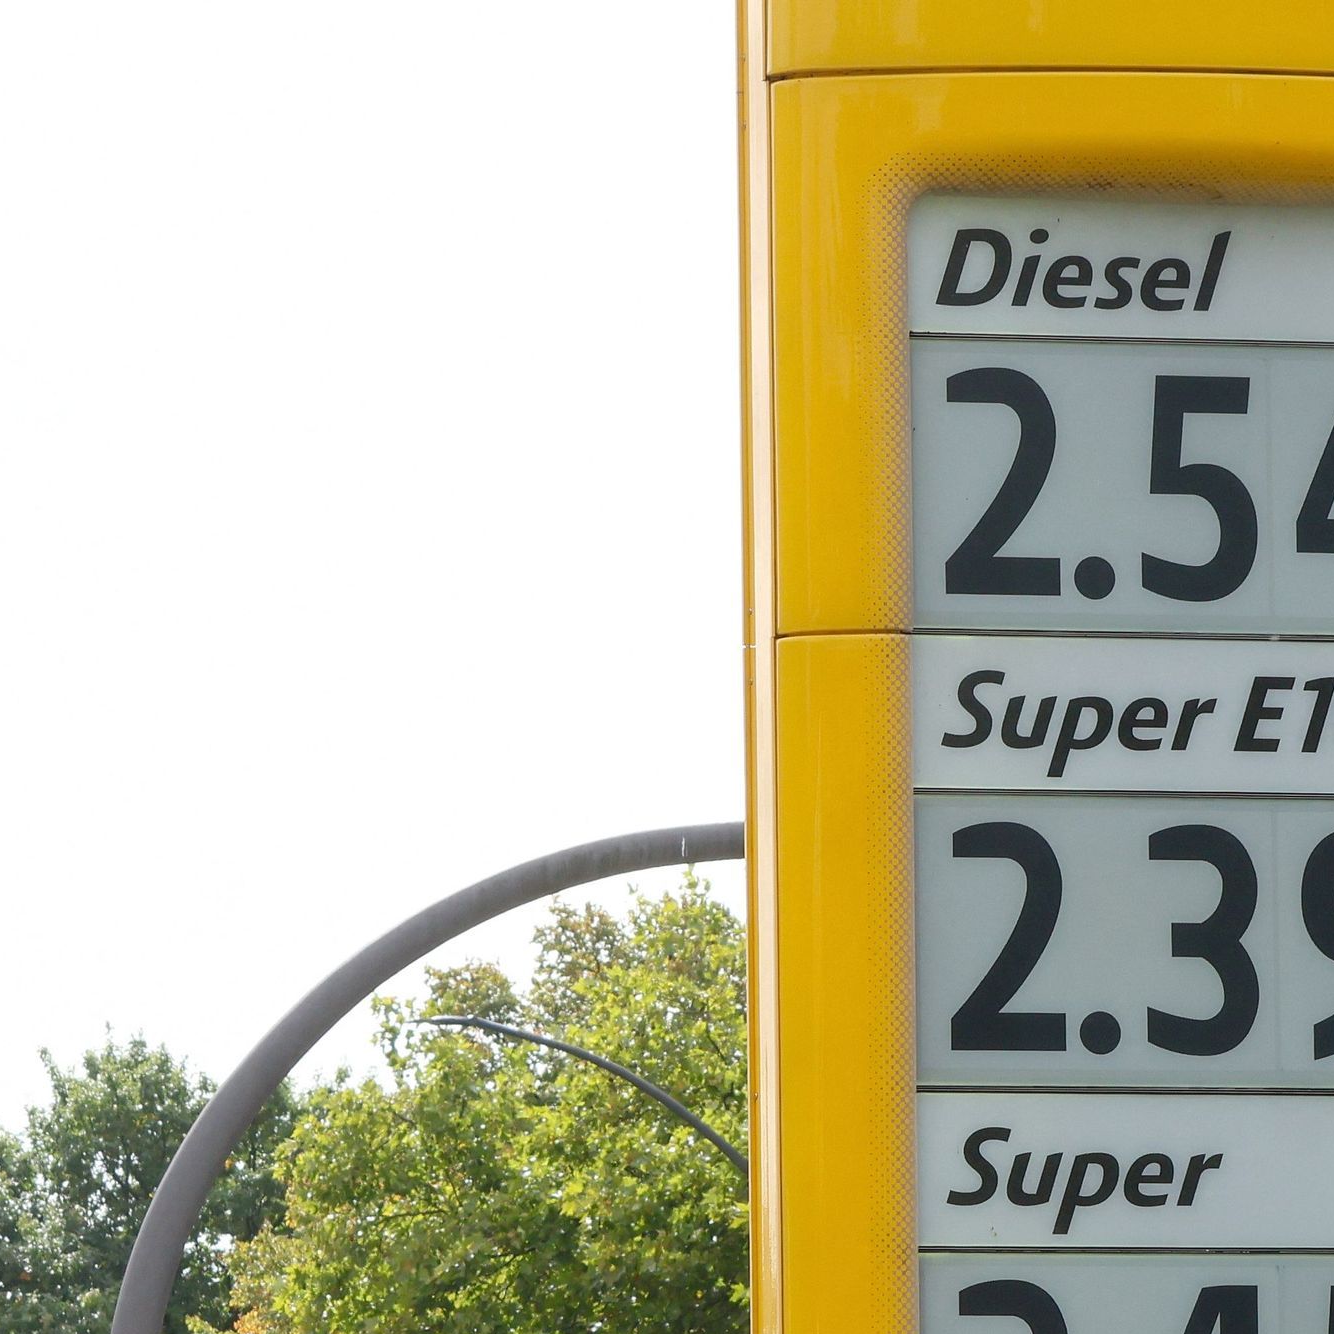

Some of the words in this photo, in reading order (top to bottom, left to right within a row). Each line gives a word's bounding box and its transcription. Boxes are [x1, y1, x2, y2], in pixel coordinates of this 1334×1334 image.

[935, 228, 1232, 312] Diesel
[940, 669, 1218, 778] Super
[946, 1126, 1224, 1235] Super
